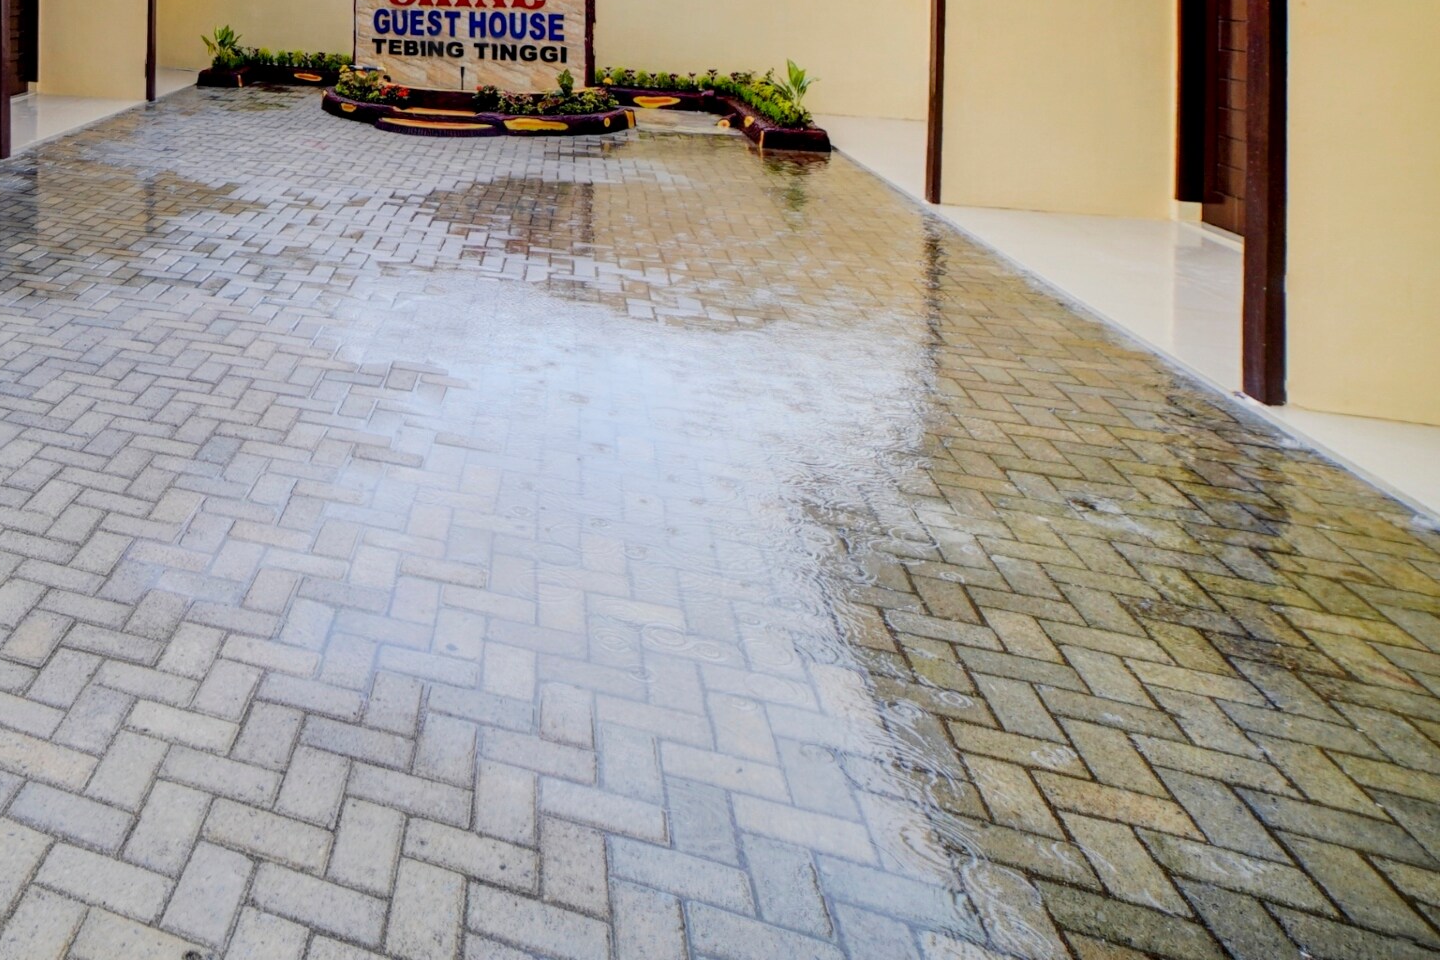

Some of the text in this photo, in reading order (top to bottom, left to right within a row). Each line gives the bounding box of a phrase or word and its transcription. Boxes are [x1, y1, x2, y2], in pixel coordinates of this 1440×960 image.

[373, 9, 565, 41] GUEST HOUSE
[372, 38, 568, 63] TEBING TINGGI
